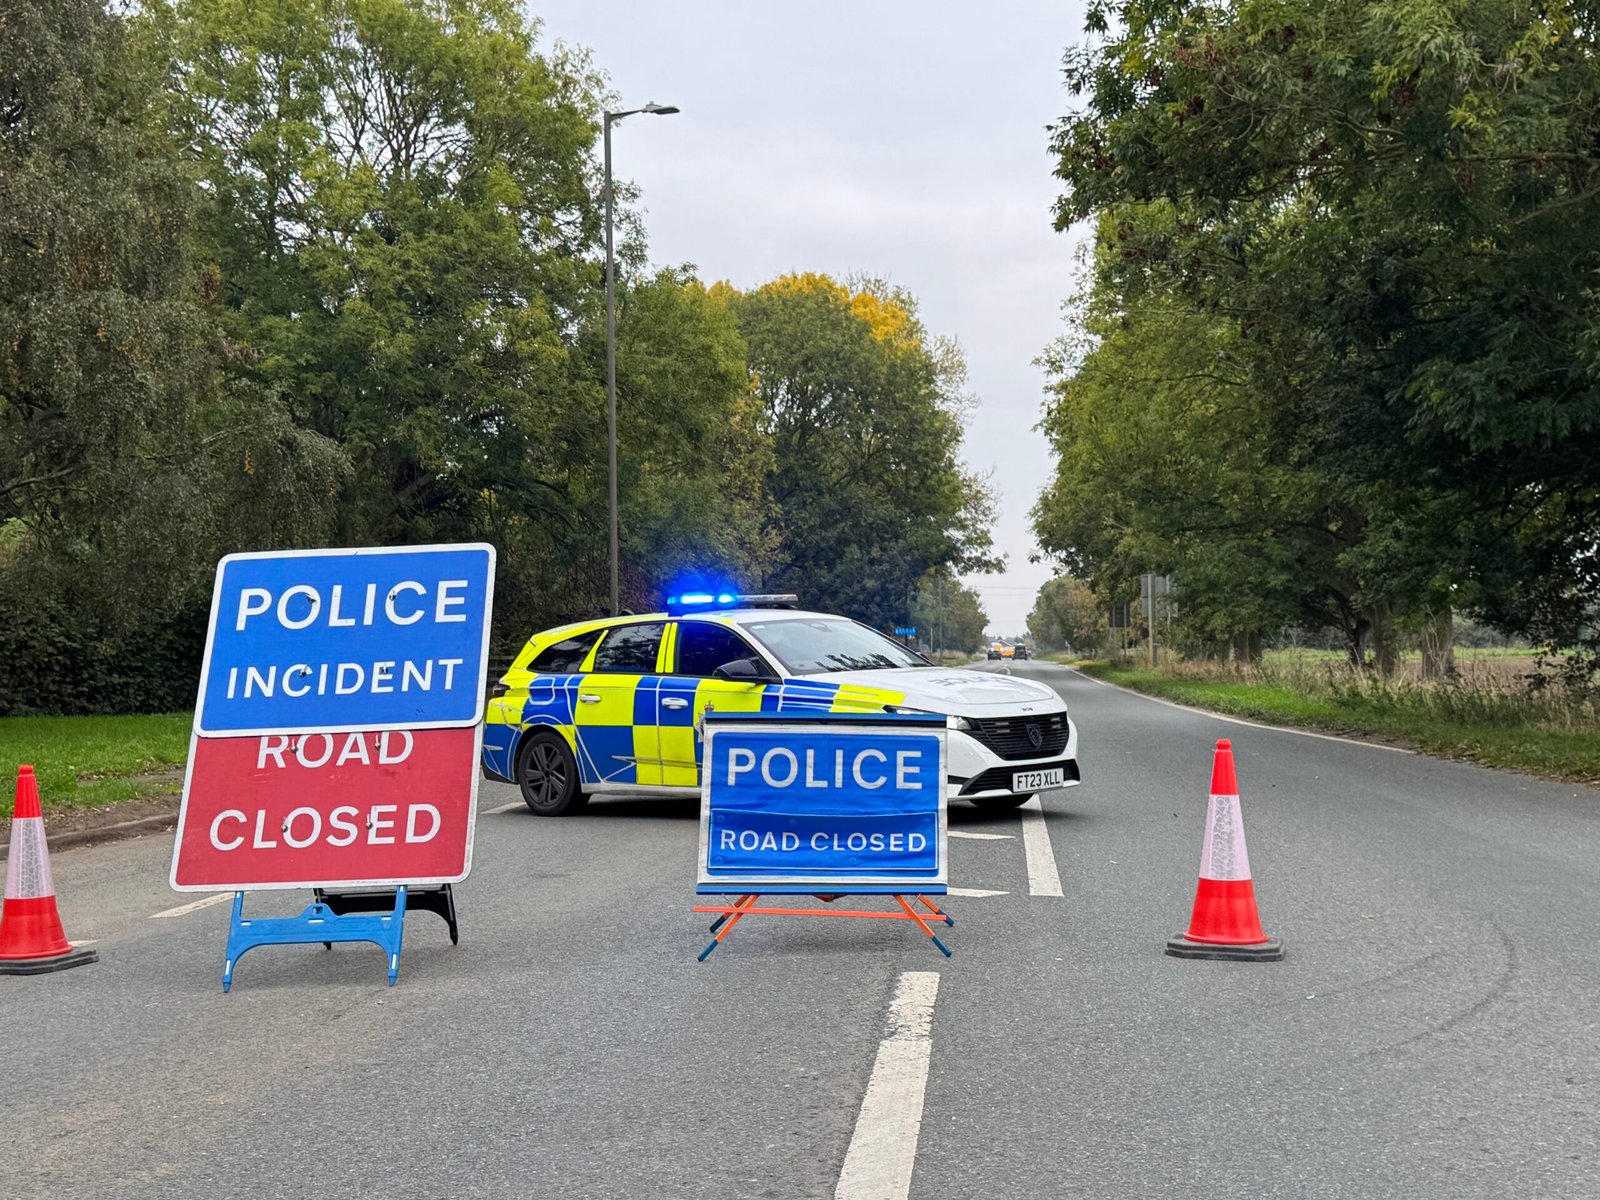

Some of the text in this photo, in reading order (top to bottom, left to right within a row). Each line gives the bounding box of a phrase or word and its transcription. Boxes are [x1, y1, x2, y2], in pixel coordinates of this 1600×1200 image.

[235, 580, 469, 631] POLICE
[226, 658, 464, 700] INCIDENT
[256, 730, 415, 769] ROAD
[727, 747, 923, 790] POLICE
[1017, 770, 1061, 790] FT23 XLL
[209, 803, 442, 852] CLOSED
[720, 829, 927, 853] ROAD CLOSED
